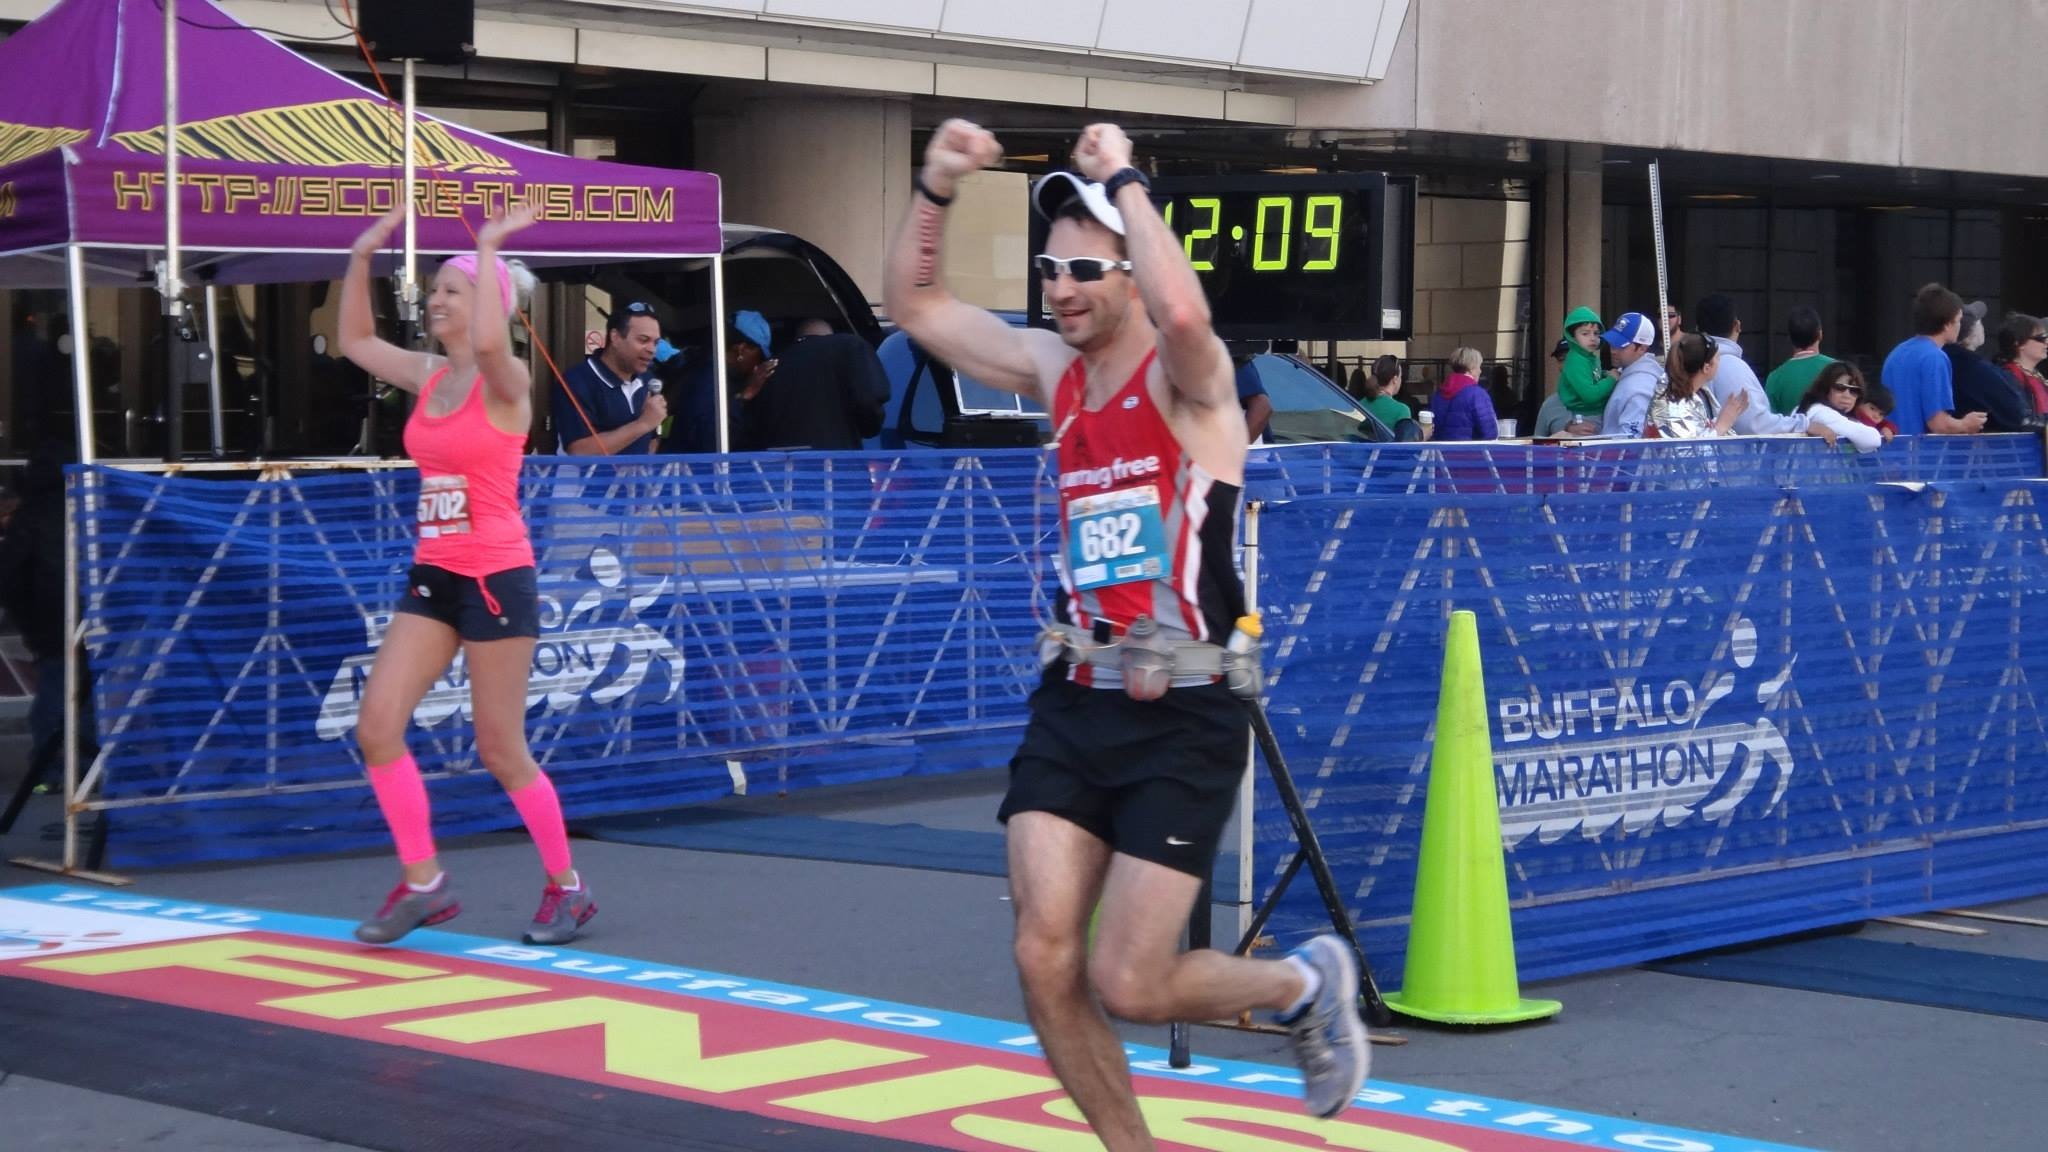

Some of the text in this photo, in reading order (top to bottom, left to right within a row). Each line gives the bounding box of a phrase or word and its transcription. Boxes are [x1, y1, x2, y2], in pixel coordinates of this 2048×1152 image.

[417, 491, 468, 522] 5702
[1079, 512, 1146, 562] 682
[1499, 680, 1695, 742] BUFFALO
[1494, 738, 1715, 807] MARATHON
[50, 892, 261, 922] 14th
[464, 944, 941, 1027] Buffalo
